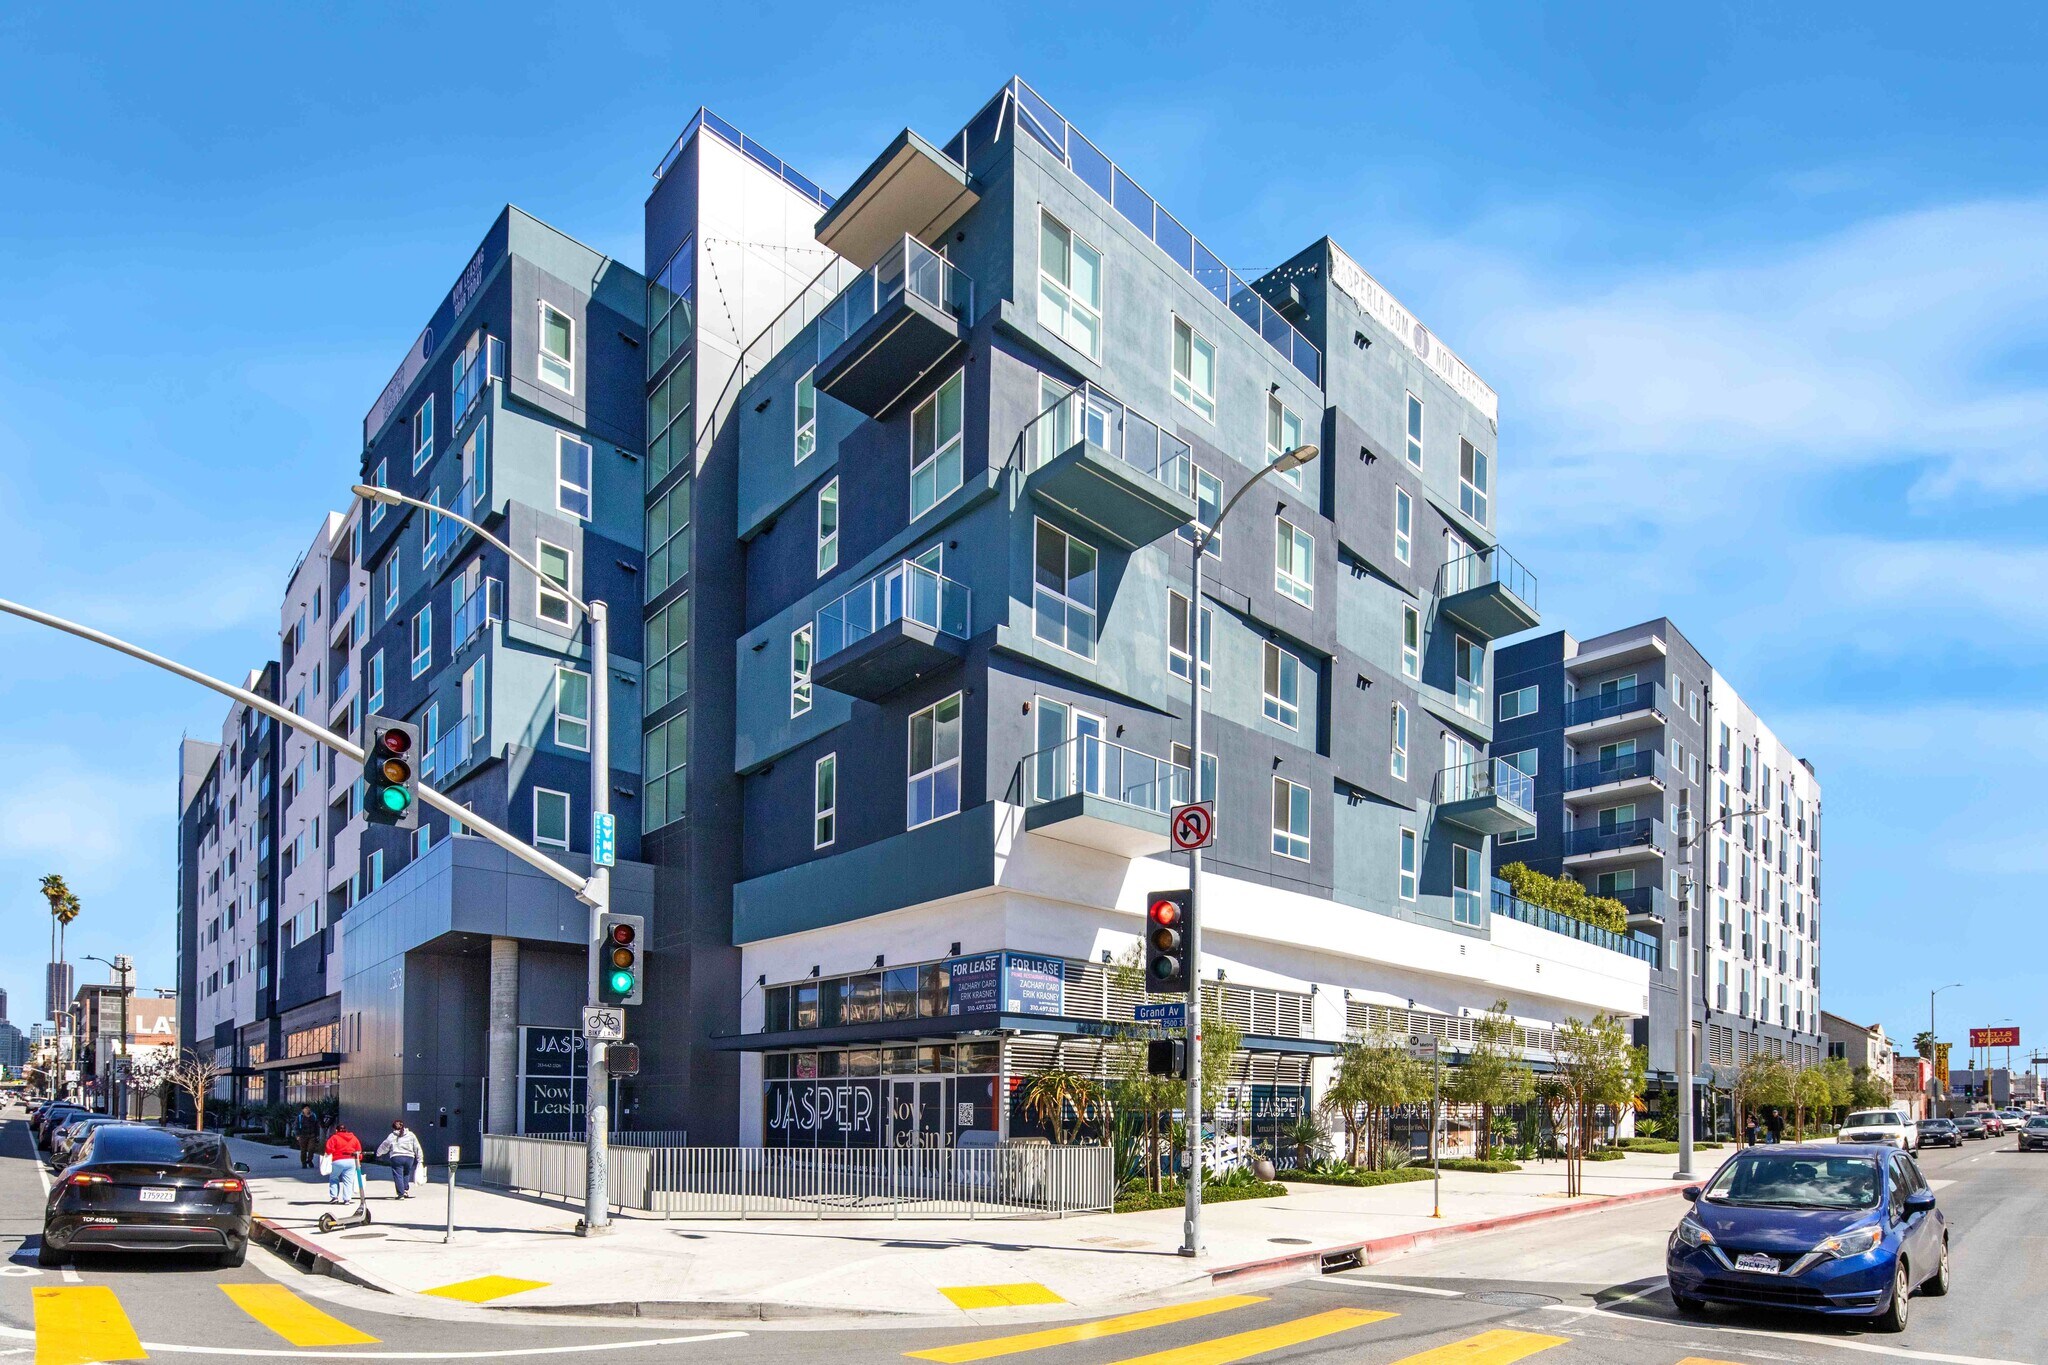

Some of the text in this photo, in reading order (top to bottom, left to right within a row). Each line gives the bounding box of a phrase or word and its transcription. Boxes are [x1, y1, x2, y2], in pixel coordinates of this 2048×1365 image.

[464, 247, 485, 288] LEASING
[1436, 346, 1454, 379] NOW
[602, 816, 613, 862] SYNC
[952, 959, 997, 977] FOR LEASE
[1011, 958, 1059, 976] FOR LEASE
[958, 980, 997, 992] ZACHARY CARD
[960, 989, 997, 1001] ERIK KRASNEY
[1020, 980, 1060, 992] ZACHARY CARD
[1023, 990, 1060, 1001] ERIK KRASNEY
[1140, 1006, 1179, 1018] Grand Av
[1977, 1030, 2013, 1038] WELLS
[1978, 1036, 2012, 1044] FARGO
[536, 1035, 588, 1053] JASP
[535, 1084, 571, 1098] Now
[534, 1100, 588, 1116] Leasin
[770, 1085, 874, 1132] JASPER
[886, 1096, 927, 1121] Now
[1256, 1096, 1305, 1118] JASPER
[885, 1124, 953, 1159] Leasing
